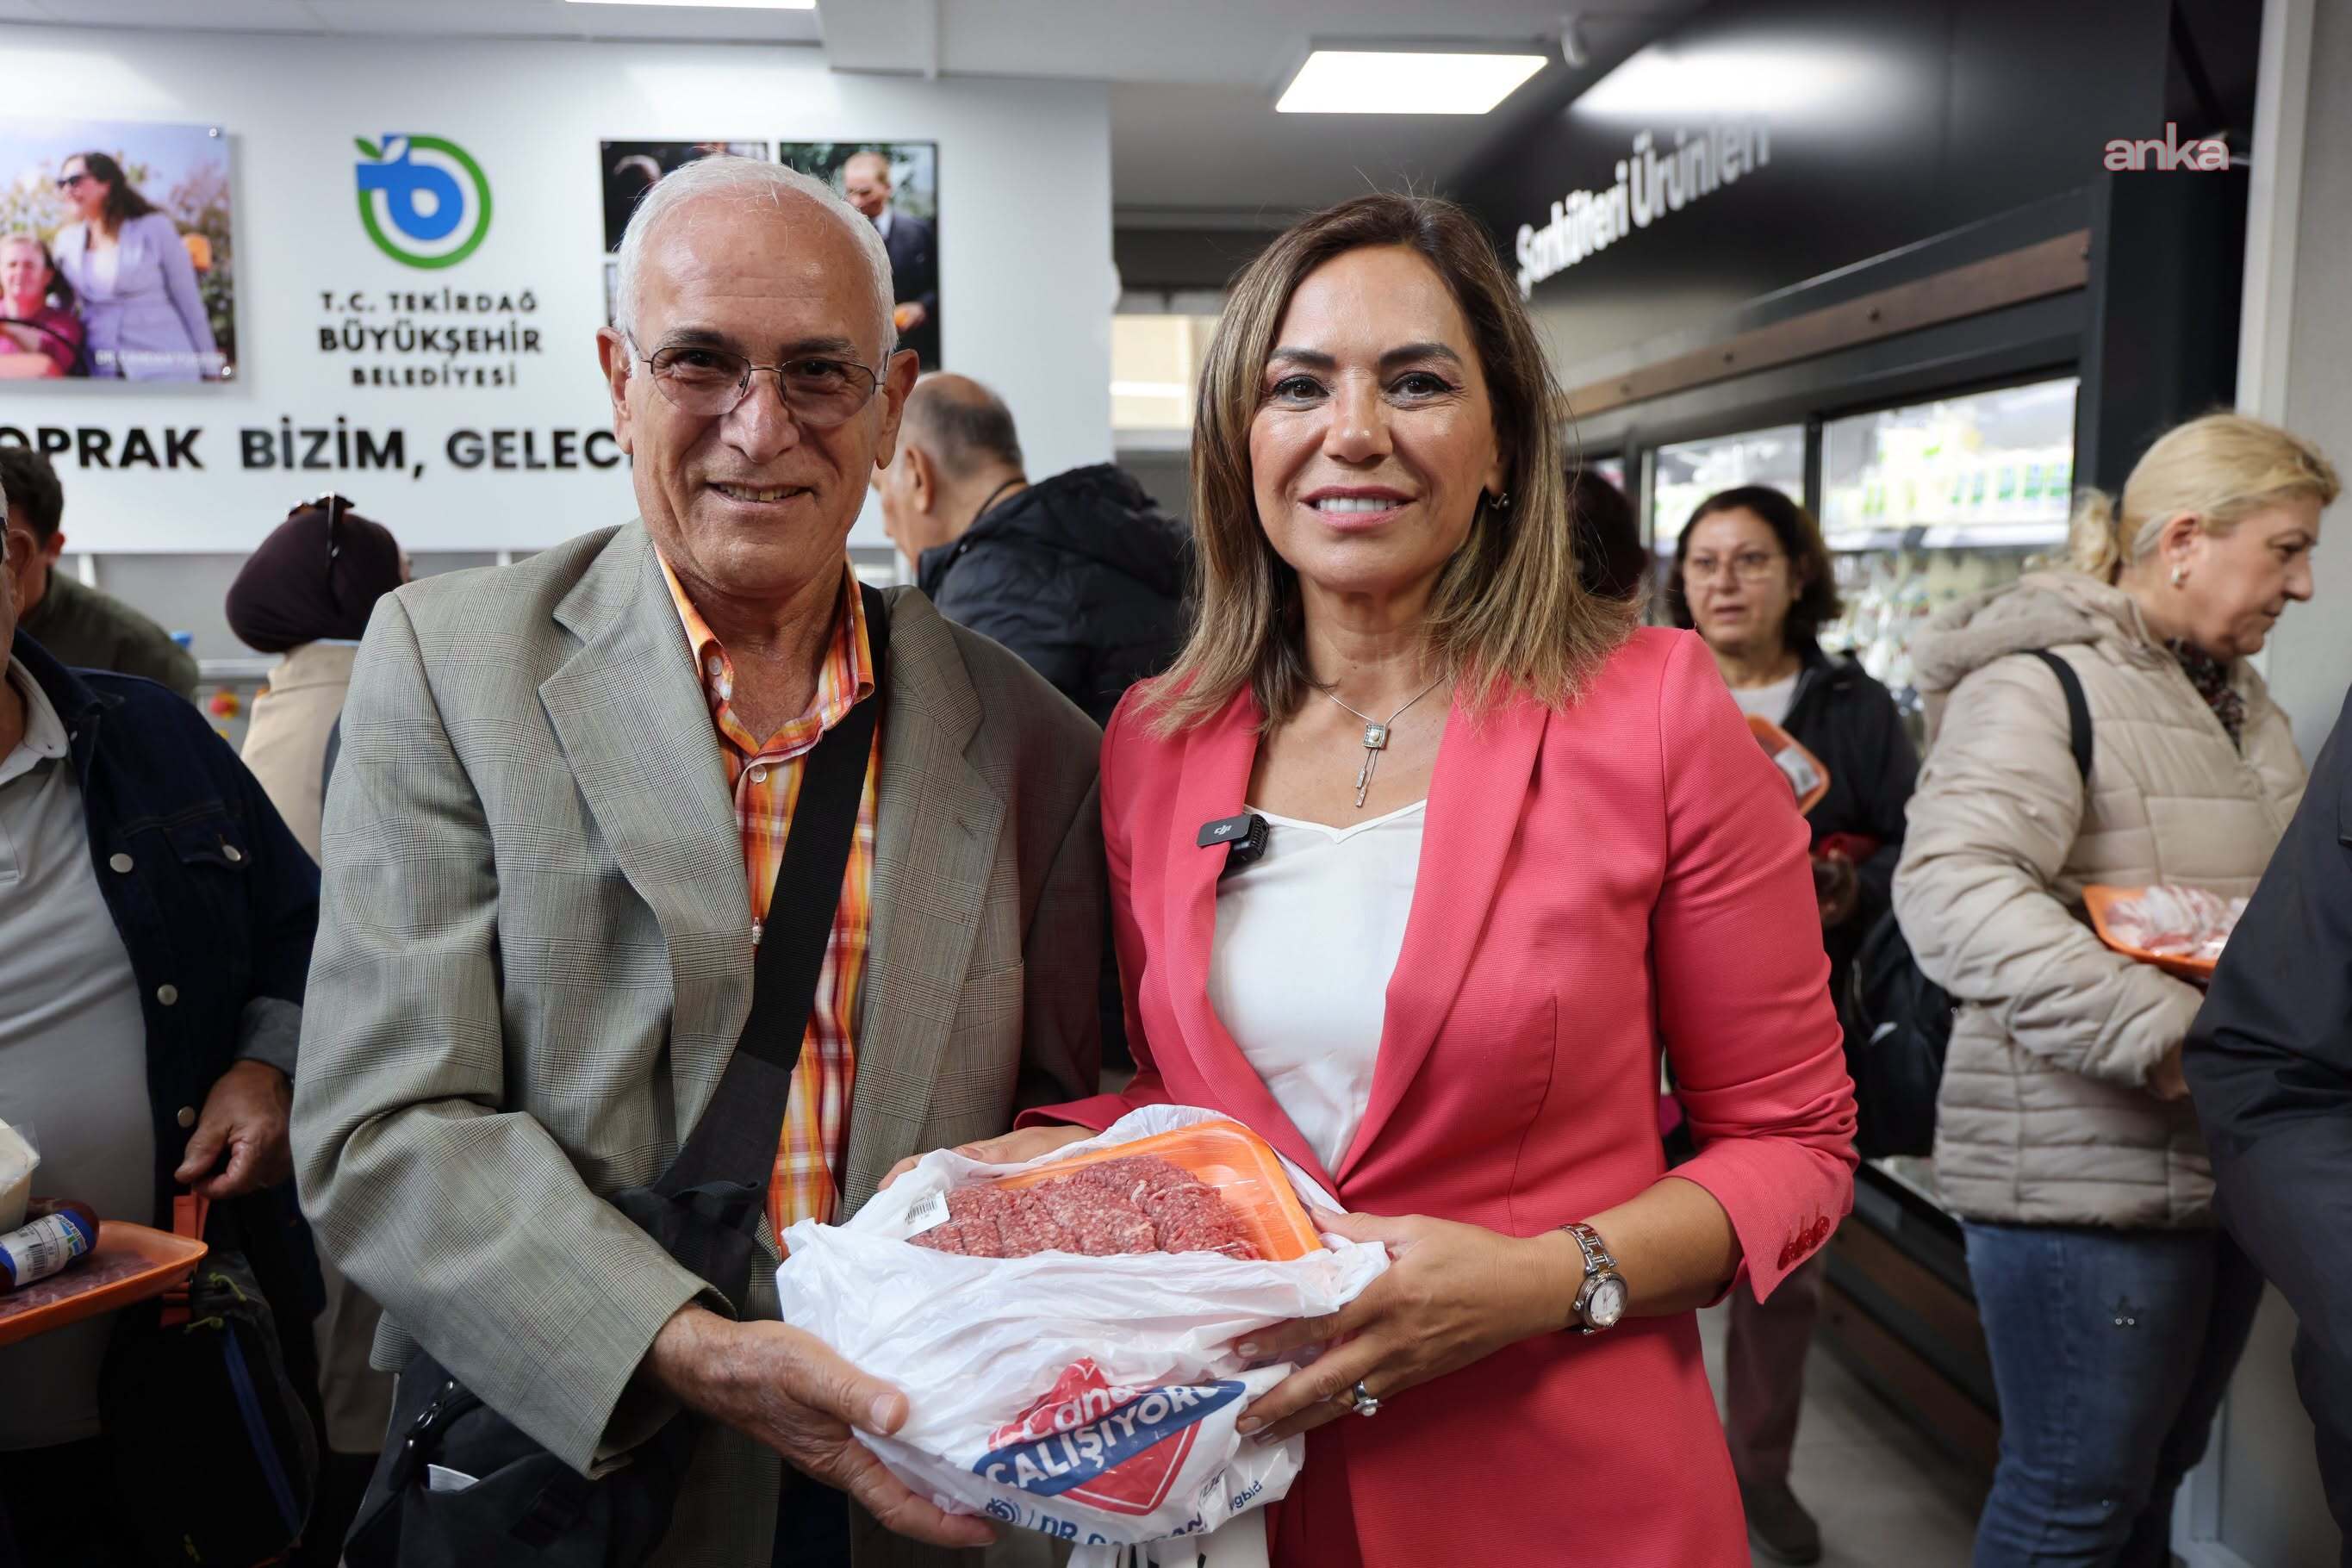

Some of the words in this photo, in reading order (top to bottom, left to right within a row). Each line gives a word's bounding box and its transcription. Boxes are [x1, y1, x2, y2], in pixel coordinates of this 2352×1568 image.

[321, 292, 376, 312] T.C.
[389, 287, 538, 313] TEKİRDAĞ
[320, 319, 541, 360] BÜYÜKŞEHİR
[352, 363, 516, 387] BELEDİYESİ
[240, 414, 425, 480] BİZİM,
[445, 430, 633, 470] GELEC
